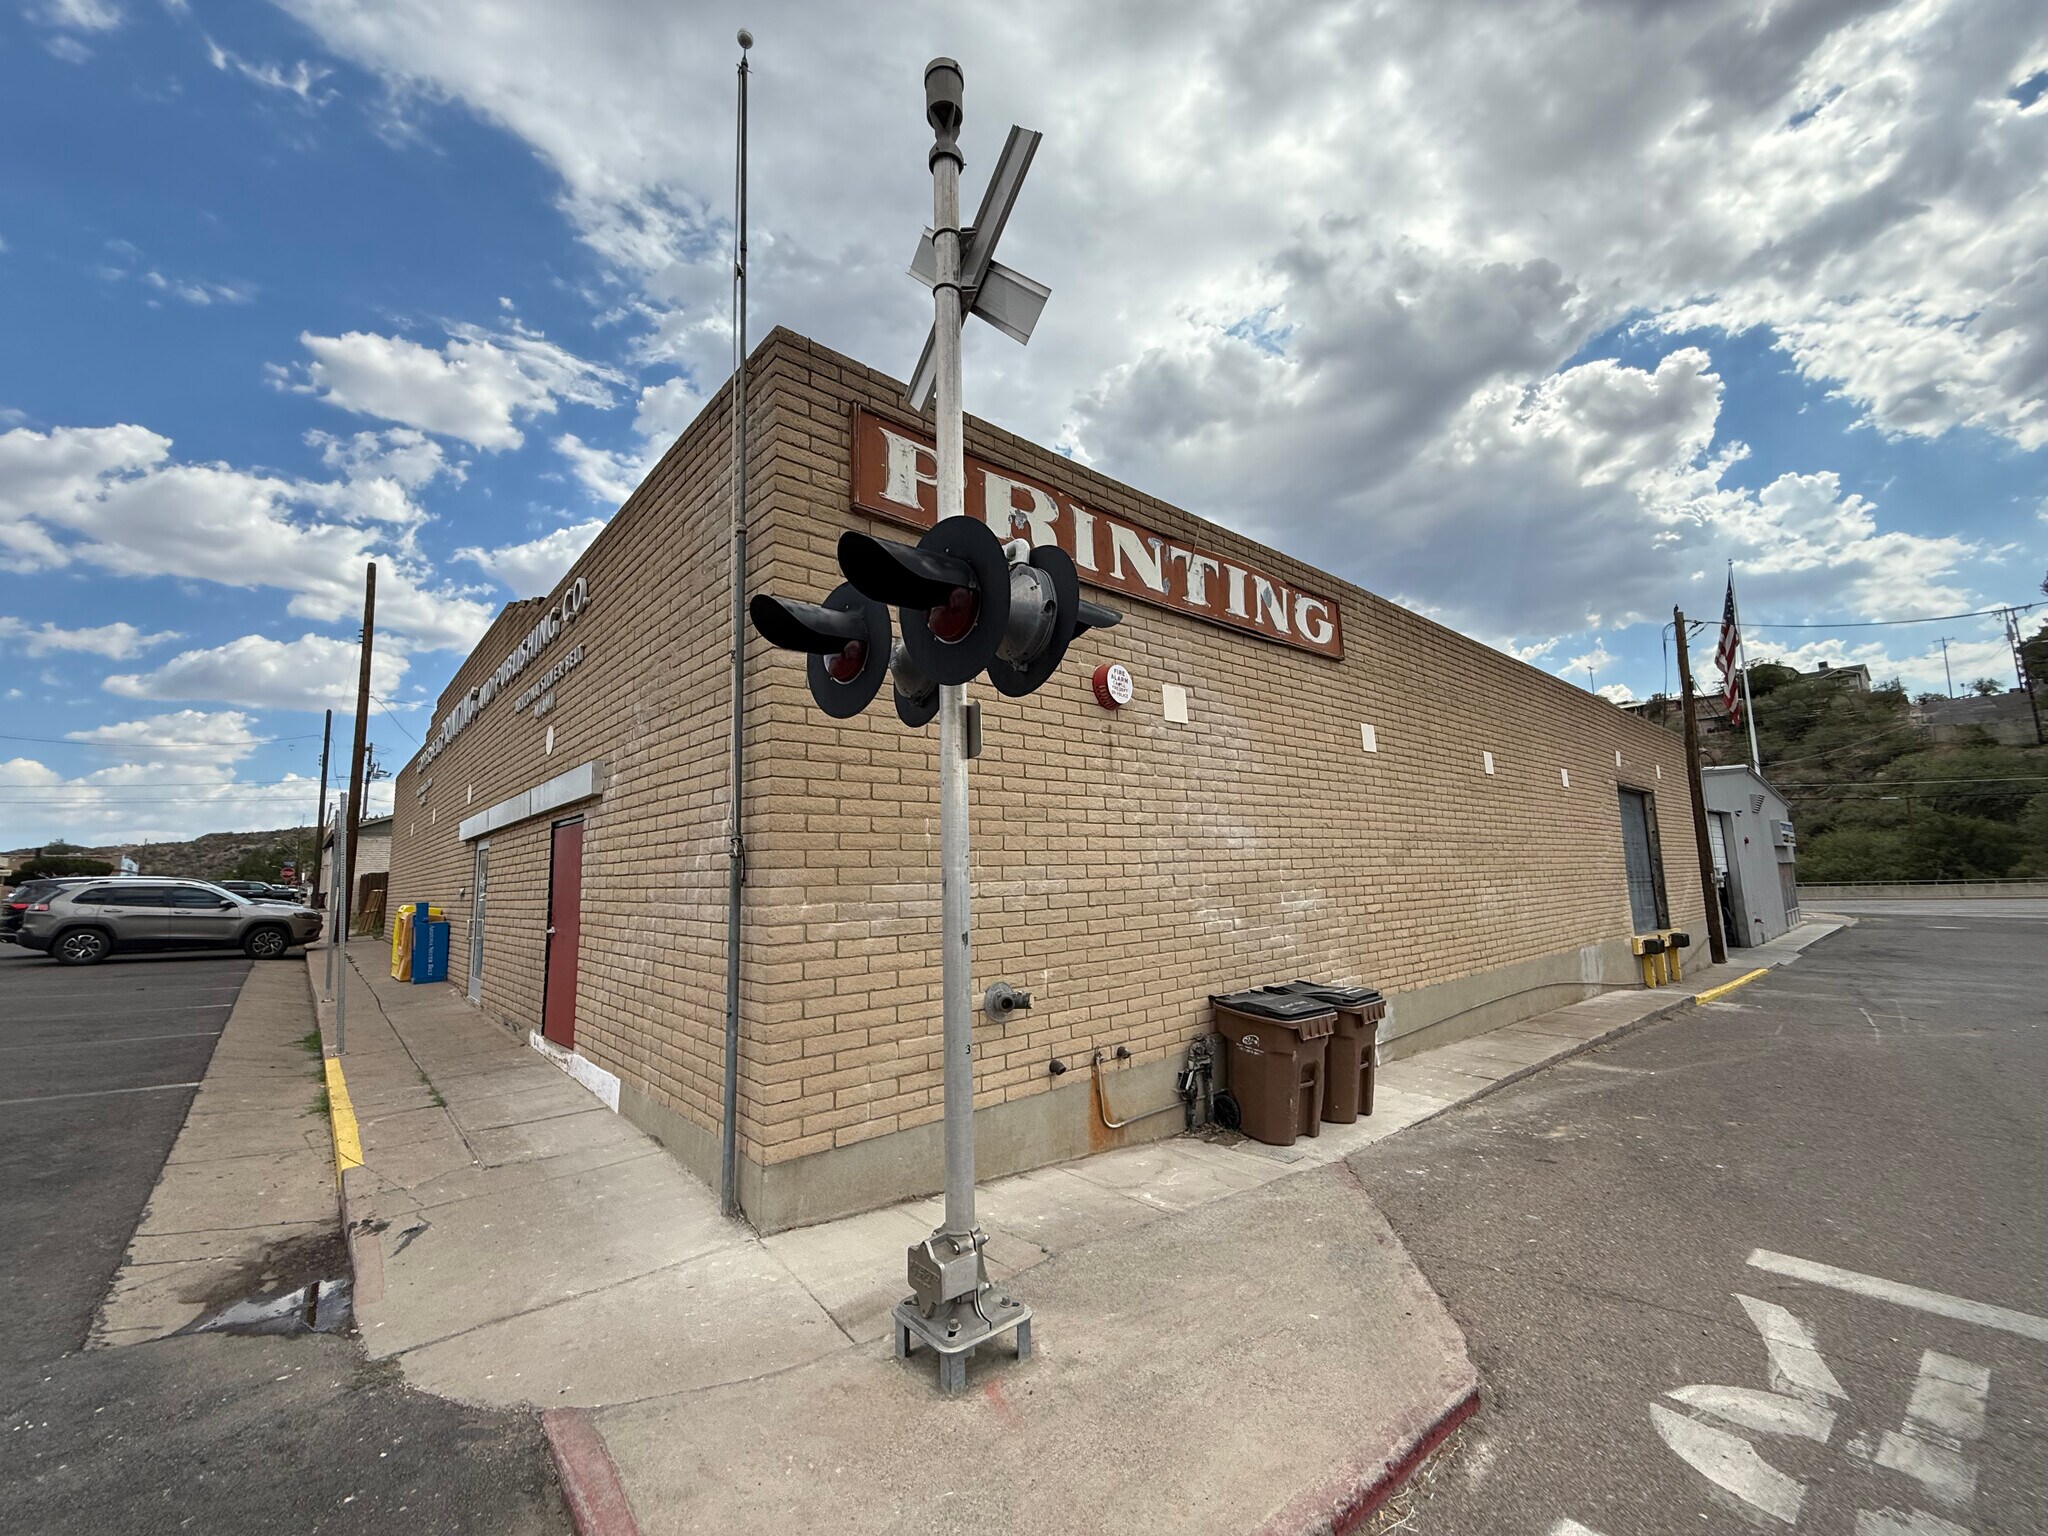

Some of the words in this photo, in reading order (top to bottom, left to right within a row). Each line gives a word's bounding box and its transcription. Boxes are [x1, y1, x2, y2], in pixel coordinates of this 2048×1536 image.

[879, 427, 1335, 644] PRINTING
[495, 606, 561, 692] PUBLISHING
[562, 577, 592, 622] CO.
[1111, 674, 1128, 683] ALARM
[1114, 668, 1125, 676] FIRE
